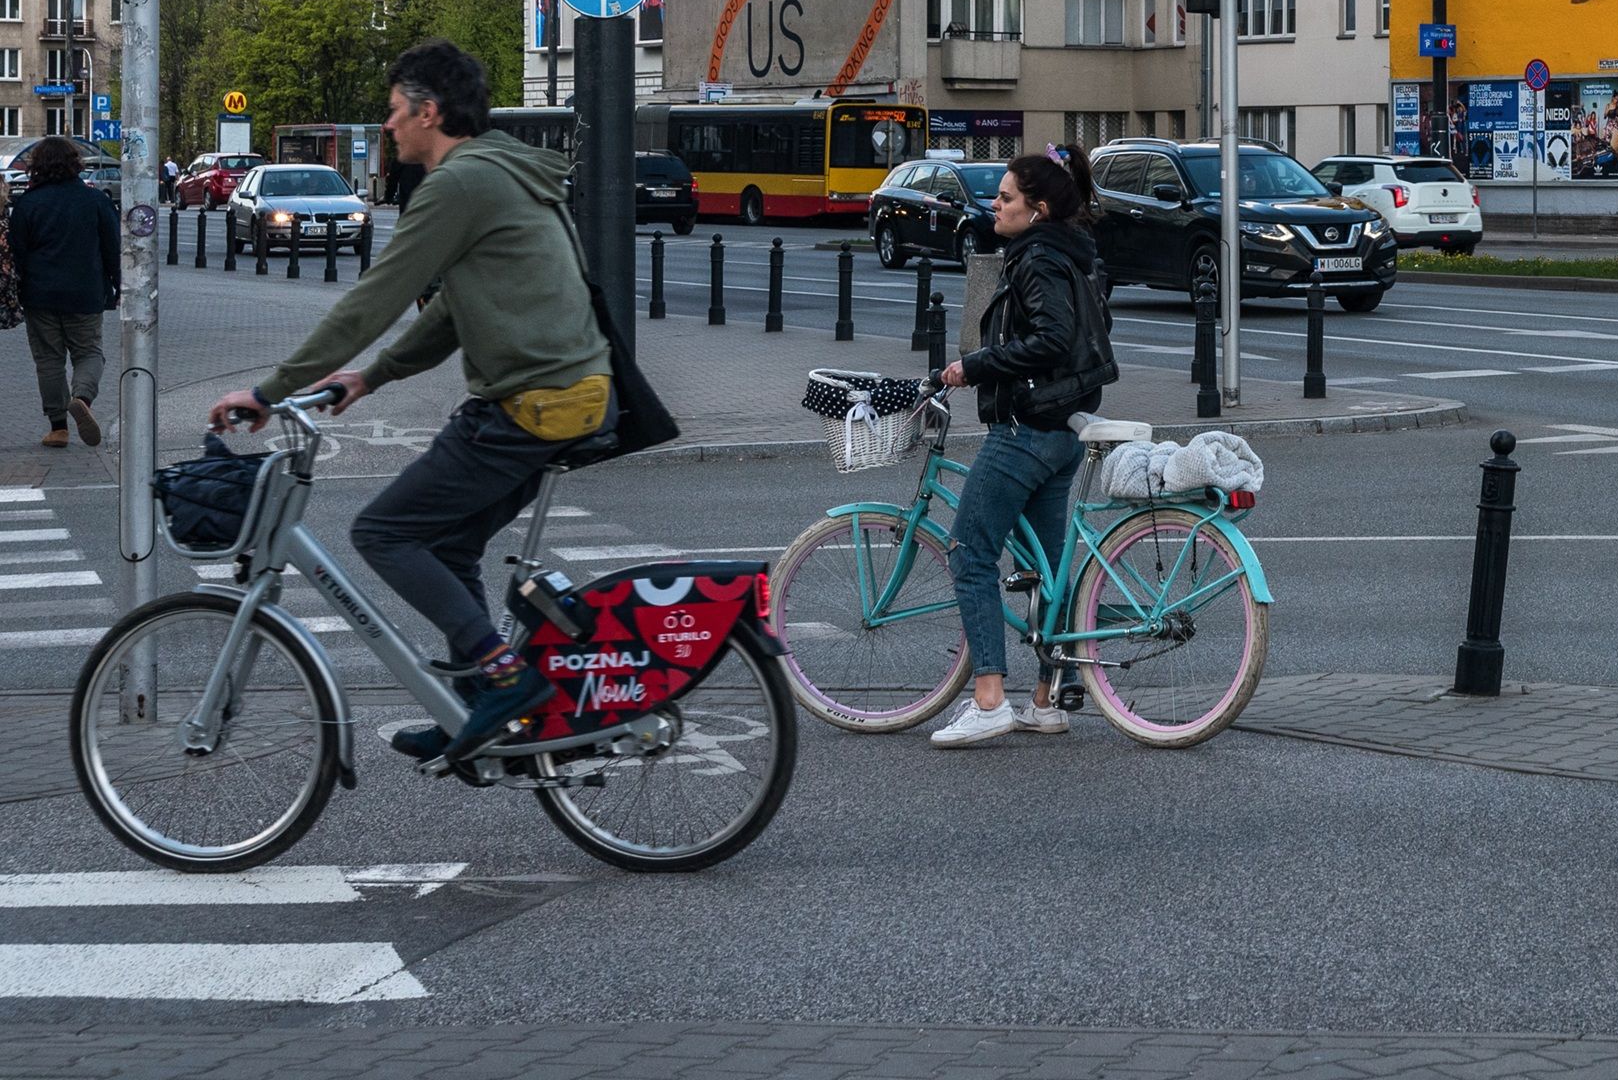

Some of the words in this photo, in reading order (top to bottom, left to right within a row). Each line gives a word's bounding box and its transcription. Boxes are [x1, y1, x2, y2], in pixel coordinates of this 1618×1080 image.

[1469, 84, 1491, 92] WELCOME
[1489, 91, 1512, 99] ORIGINALS
[96, 96, 107, 108] P
[1546, 108, 1570, 121] NIEBO
[314, 565, 370, 625] VETURILO
[548, 650, 650, 671] POZNAJ
[574, 671, 647, 718] Nowe
[827, 708, 866, 723] KENDA
